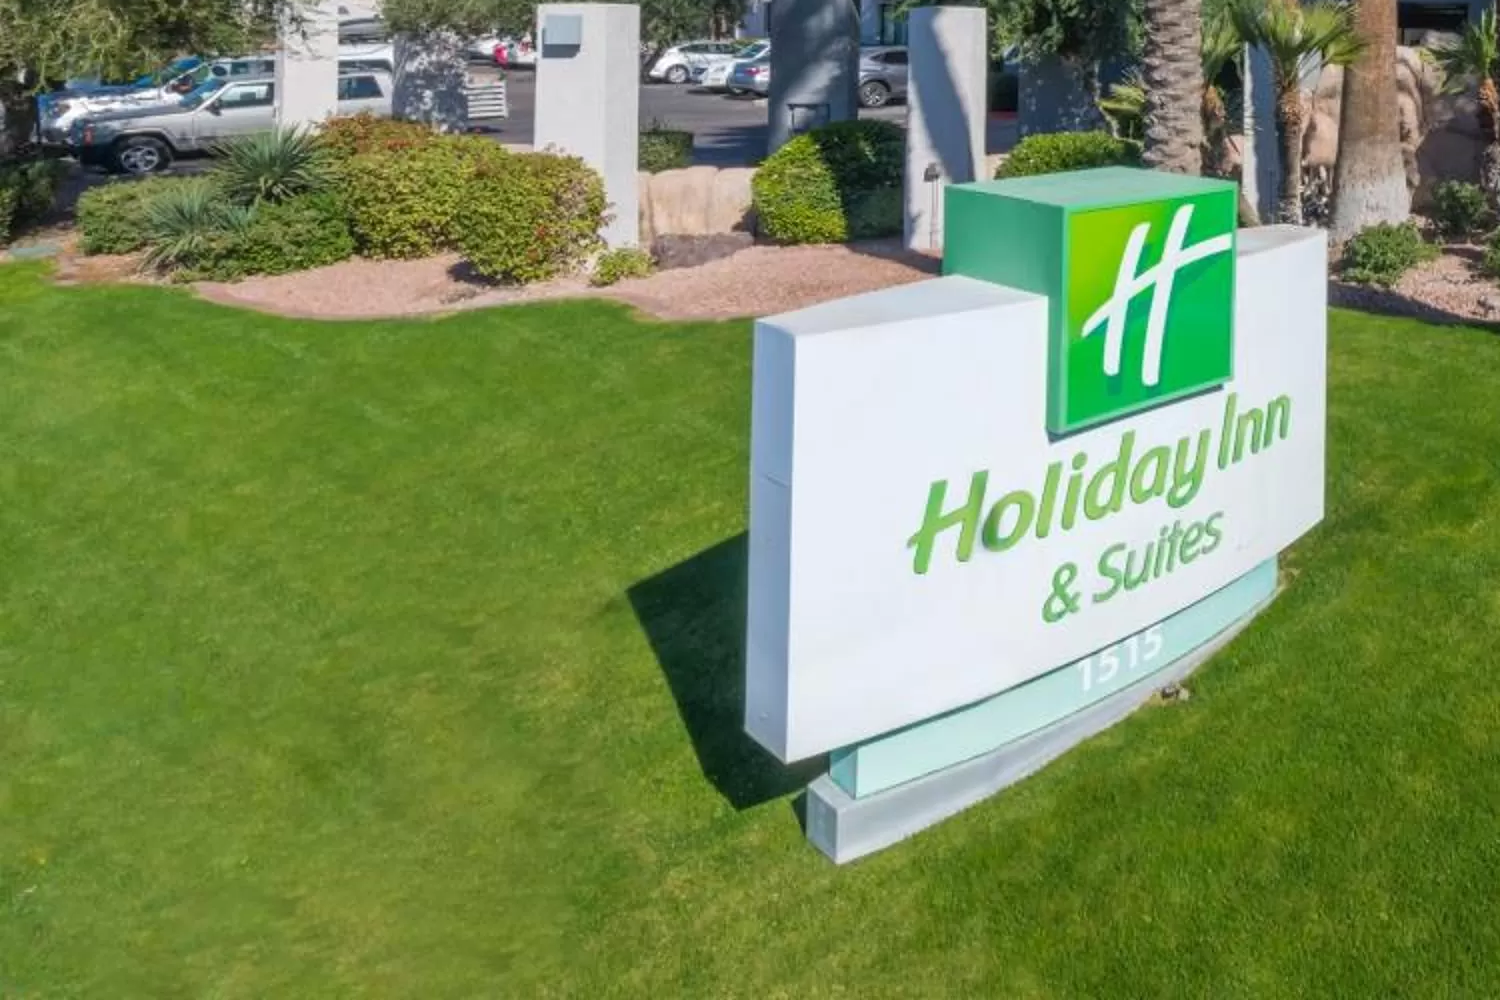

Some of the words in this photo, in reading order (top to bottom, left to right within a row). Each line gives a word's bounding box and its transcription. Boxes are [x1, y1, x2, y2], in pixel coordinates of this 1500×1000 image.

[906, 428, 1212, 575] Holiday
[1216, 392, 1293, 470] Inn
[1041, 561, 1082, 623] &
[1092, 511, 1225, 604] Suites
[1077, 625, 1164, 692] 1515
